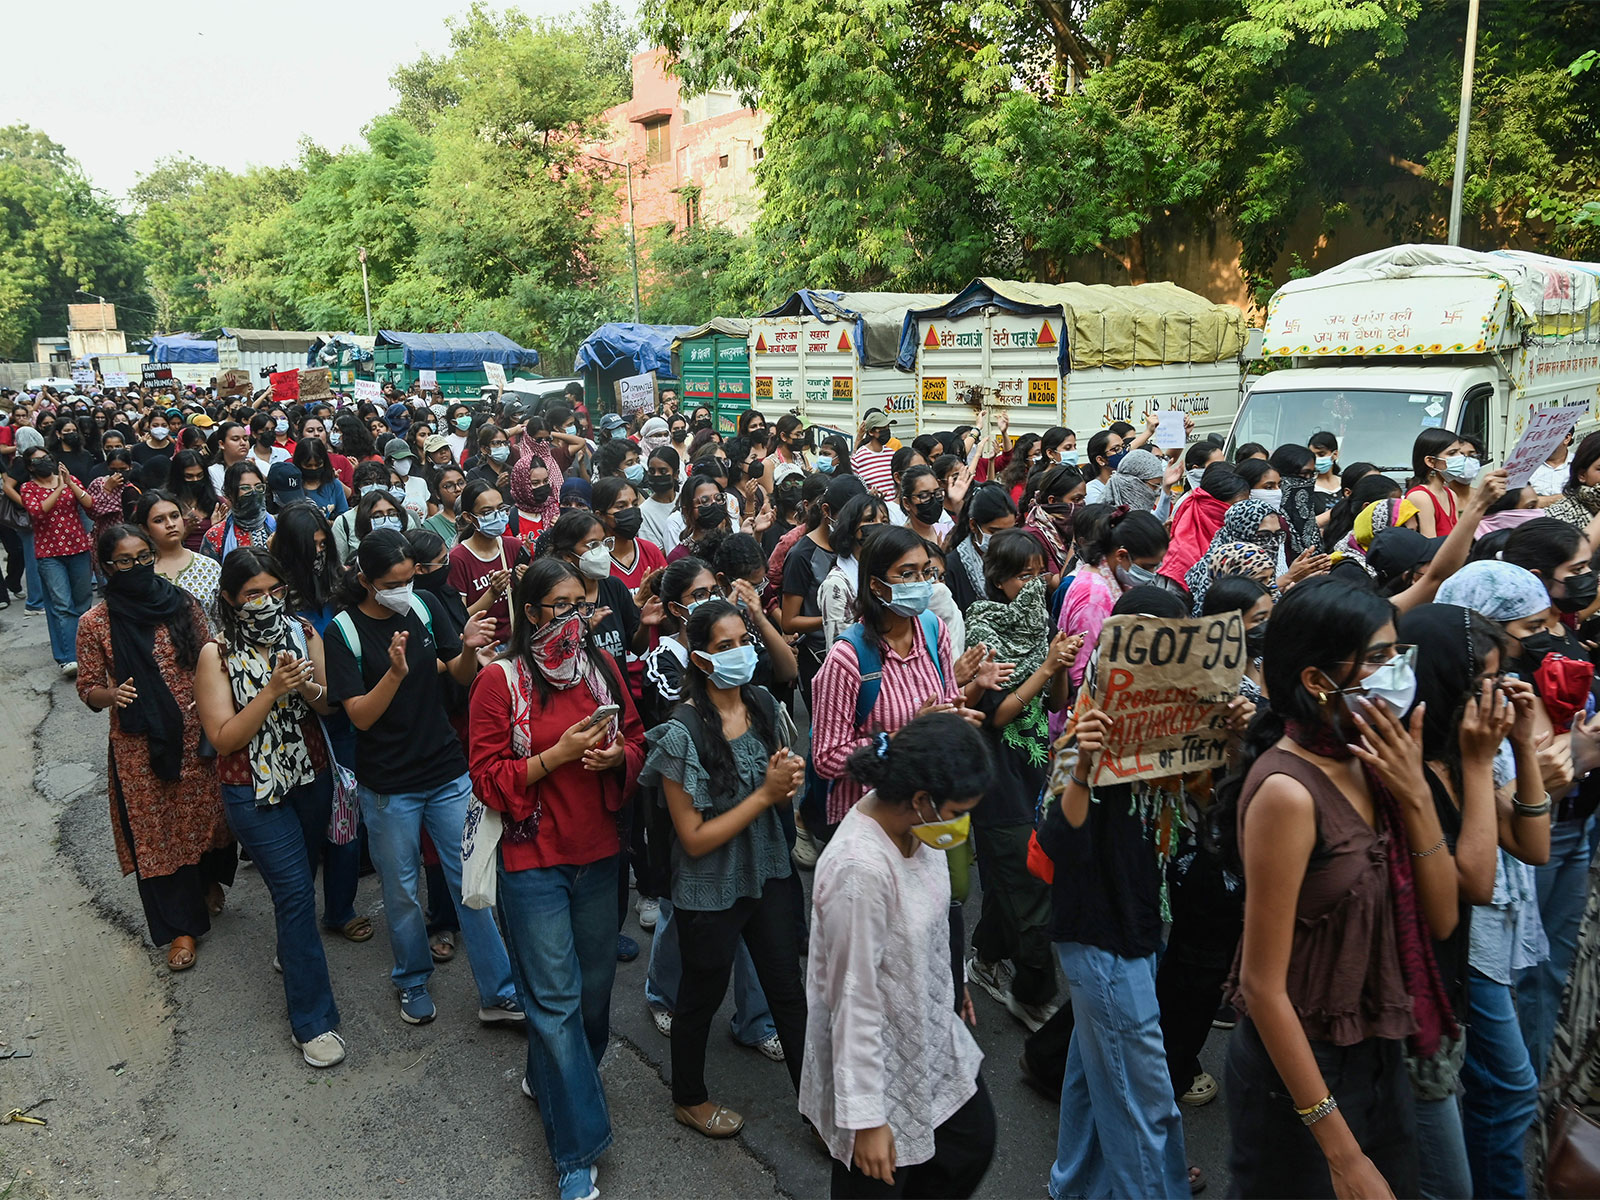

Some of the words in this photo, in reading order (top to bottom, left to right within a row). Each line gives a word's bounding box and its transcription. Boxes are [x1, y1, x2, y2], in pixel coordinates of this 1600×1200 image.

[1125, 624, 1201, 666] GOT
[1202, 614, 1243, 670] 99
[1101, 668, 1199, 712] PROBLEMS
[1105, 704, 1215, 747] ATRIARCHY
[1092, 744, 1154, 785] ALL
[1181, 734, 1230, 766] THEM
